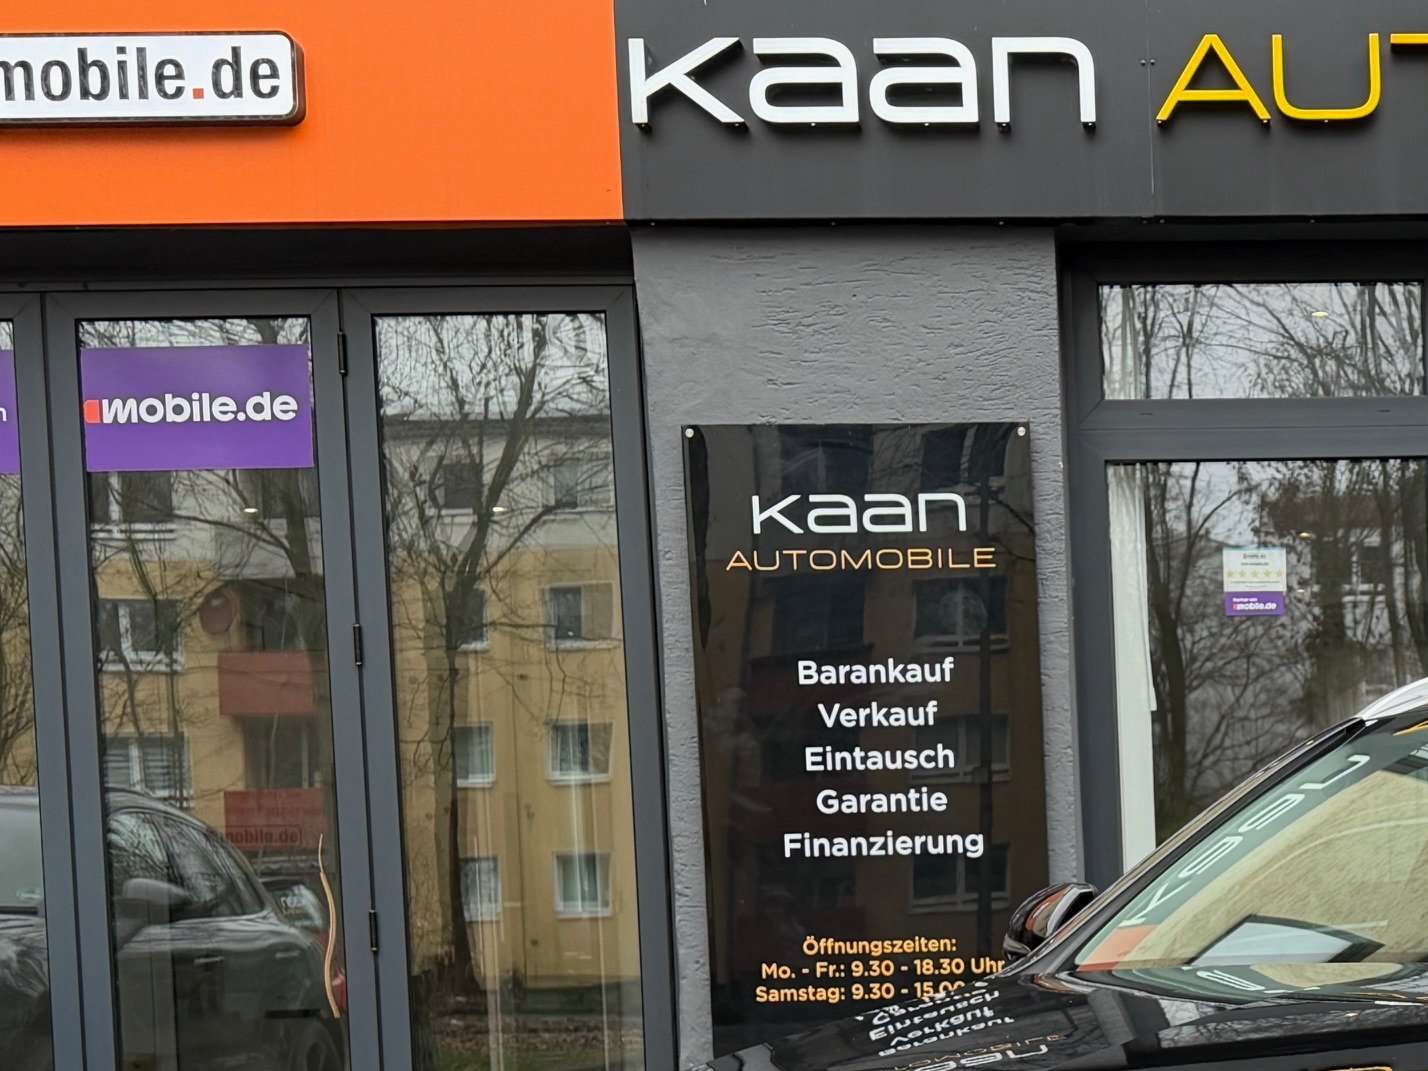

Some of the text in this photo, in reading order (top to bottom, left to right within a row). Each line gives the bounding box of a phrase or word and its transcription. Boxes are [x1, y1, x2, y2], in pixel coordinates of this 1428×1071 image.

[102, 391, 298, 424] mobile.de
[726, 547, 997, 571] AUTOMOBILE
[798, 656, 954, 685] Barankauf
[817, 700, 938, 728] Verkauf
[804, 743, 955, 771] Eintausch
[816, 786, 948, 814] Garantie
[783, 830, 984, 858] Finanzierung
[802, 935, 957, 956] Öffnungszeiten:
[761, 963, 796, 979] Mo.
[815, 961, 845, 977] Fr.:
[850, 959, 894, 977] 9.30
[913, 957, 965, 976] 18.30
[970, 957, 1005, 974] Uhr
[755, 986, 846, 1004] Samstag:
[851, 983, 895, 999] 9.30
